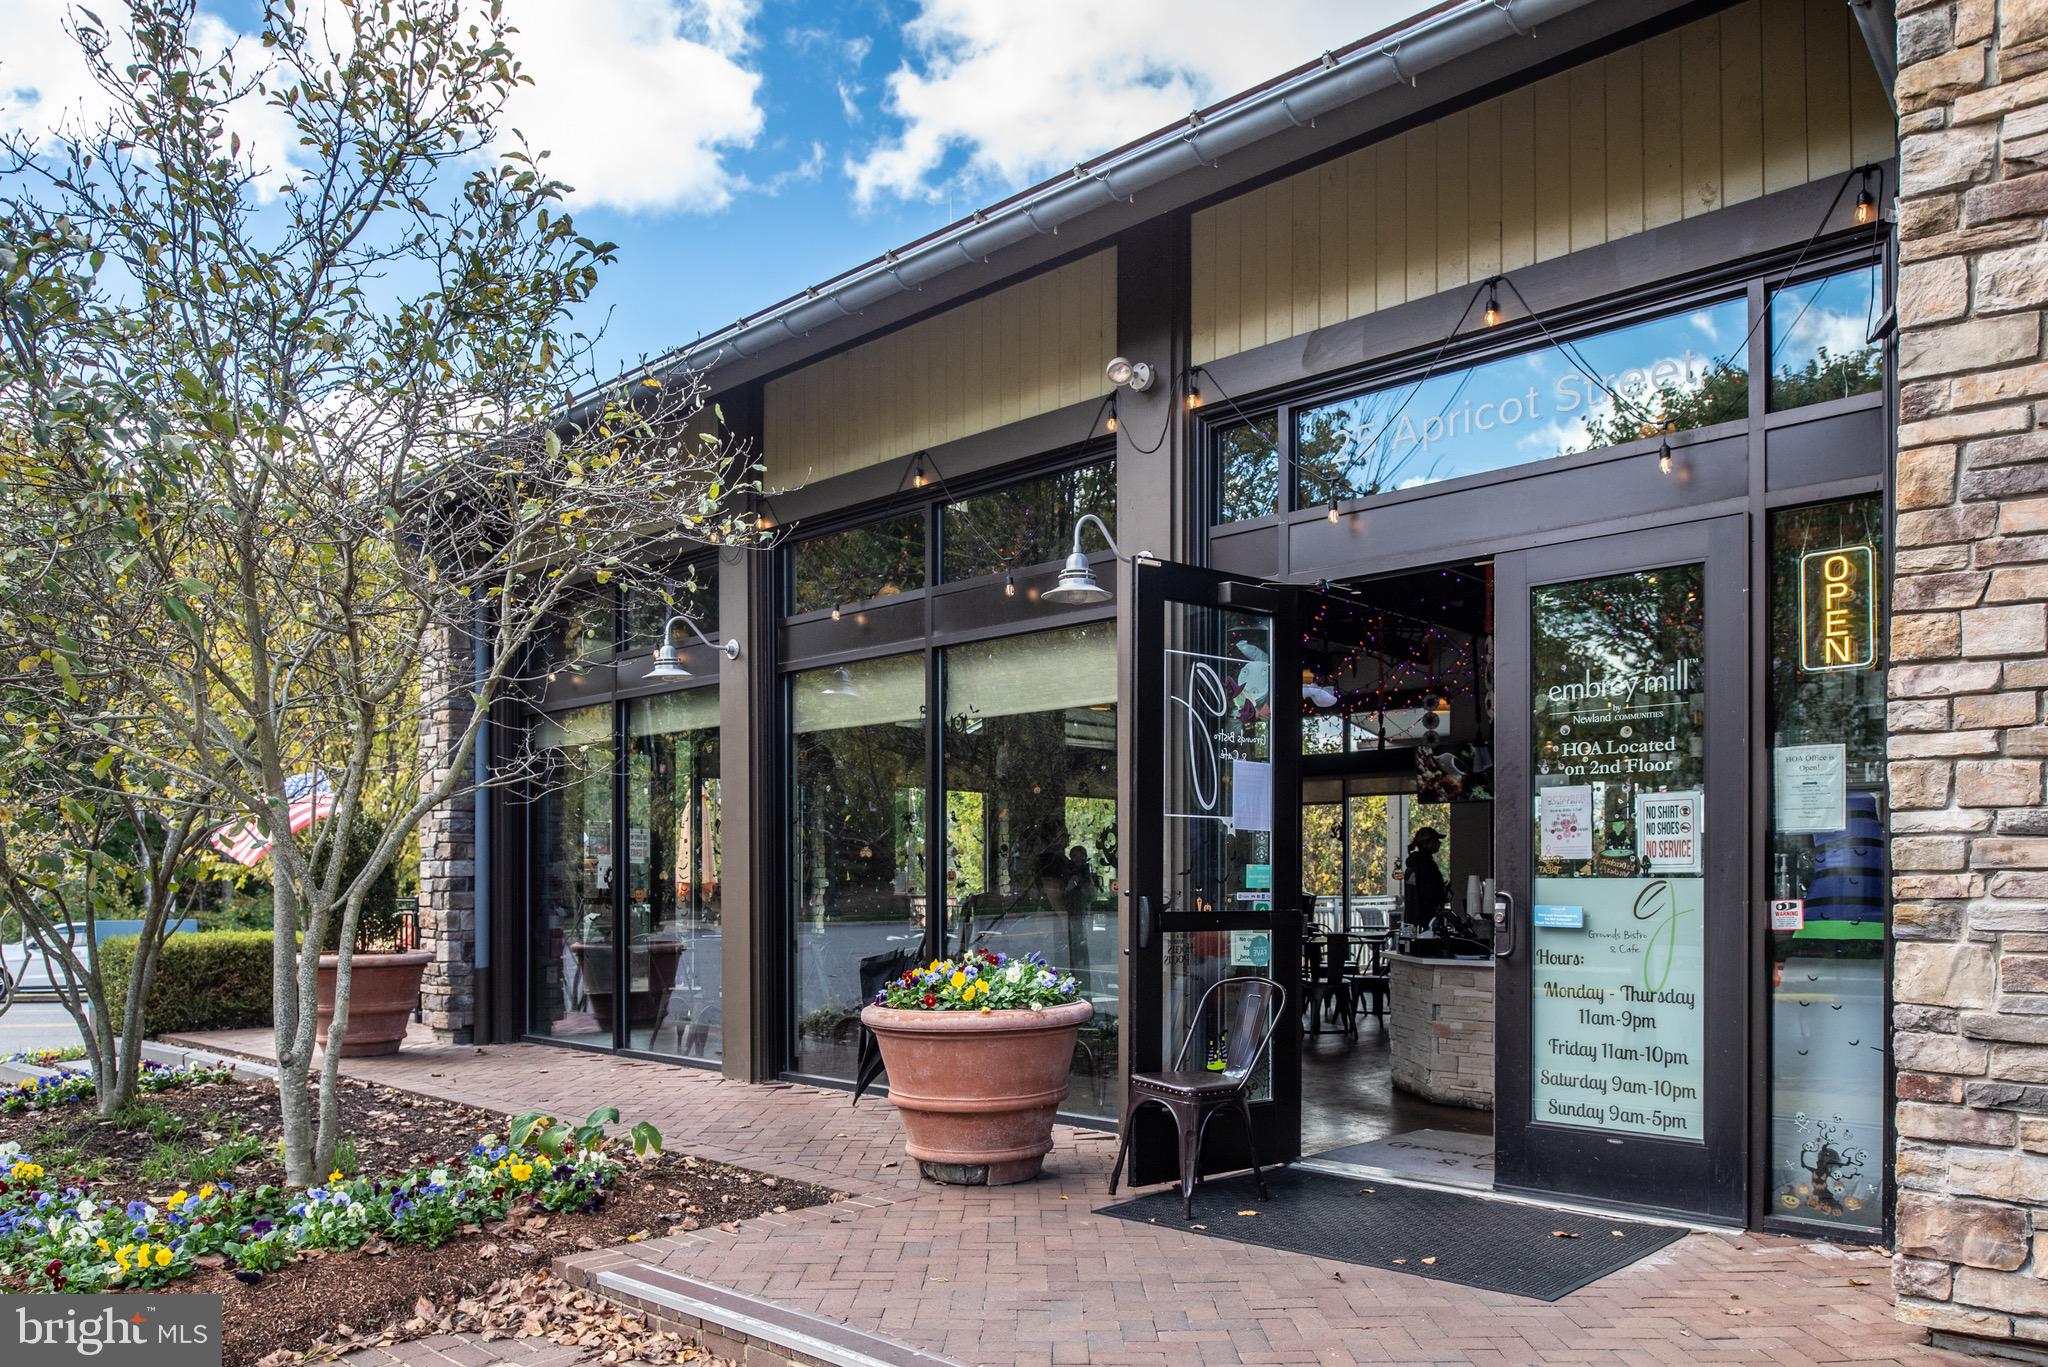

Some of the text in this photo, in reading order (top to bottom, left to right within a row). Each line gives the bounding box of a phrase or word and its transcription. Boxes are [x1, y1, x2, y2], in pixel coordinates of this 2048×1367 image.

[1392, 387, 1541, 452] Apricot
[1555, 349, 1697, 412] Street
[1825, 555, 1850, 664] OPEN
[1549, 669, 1639, 702] embrey
[1645, 659, 1688, 693] mill
[1573, 711, 1664, 725] Newland COMMUNITIES
[1613, 704, 1622, 713] by
[1562, 737, 1677, 757] HOA Located
[1565, 758, 1673, 776] on 2nd Floor
[1786, 755, 1803, 763] HOA
[1805, 754, 1828, 762] Office
[1646, 805, 1679, 819] NO SHIRT
[1646, 821, 1680, 835] NO SHOES
[1646, 840, 1691, 858] NO SERVICE
[1588, 928, 1648, 940] Grounds Bistro
[1536, 949, 1584, 965] Hours:
[1544, 981, 1604, 1004] Monday
[1620, 985, 1695, 1009] Thursday
[1578, 1009, 1656, 1032] 11am-9pm
[1549, 1038, 1689, 1068] Friday 11am-10pm
[1541, 1070, 1697, 1102] Saturday 9am-10pm
[1549, 1099, 1687, 1131] Sunday 9am-5pm
